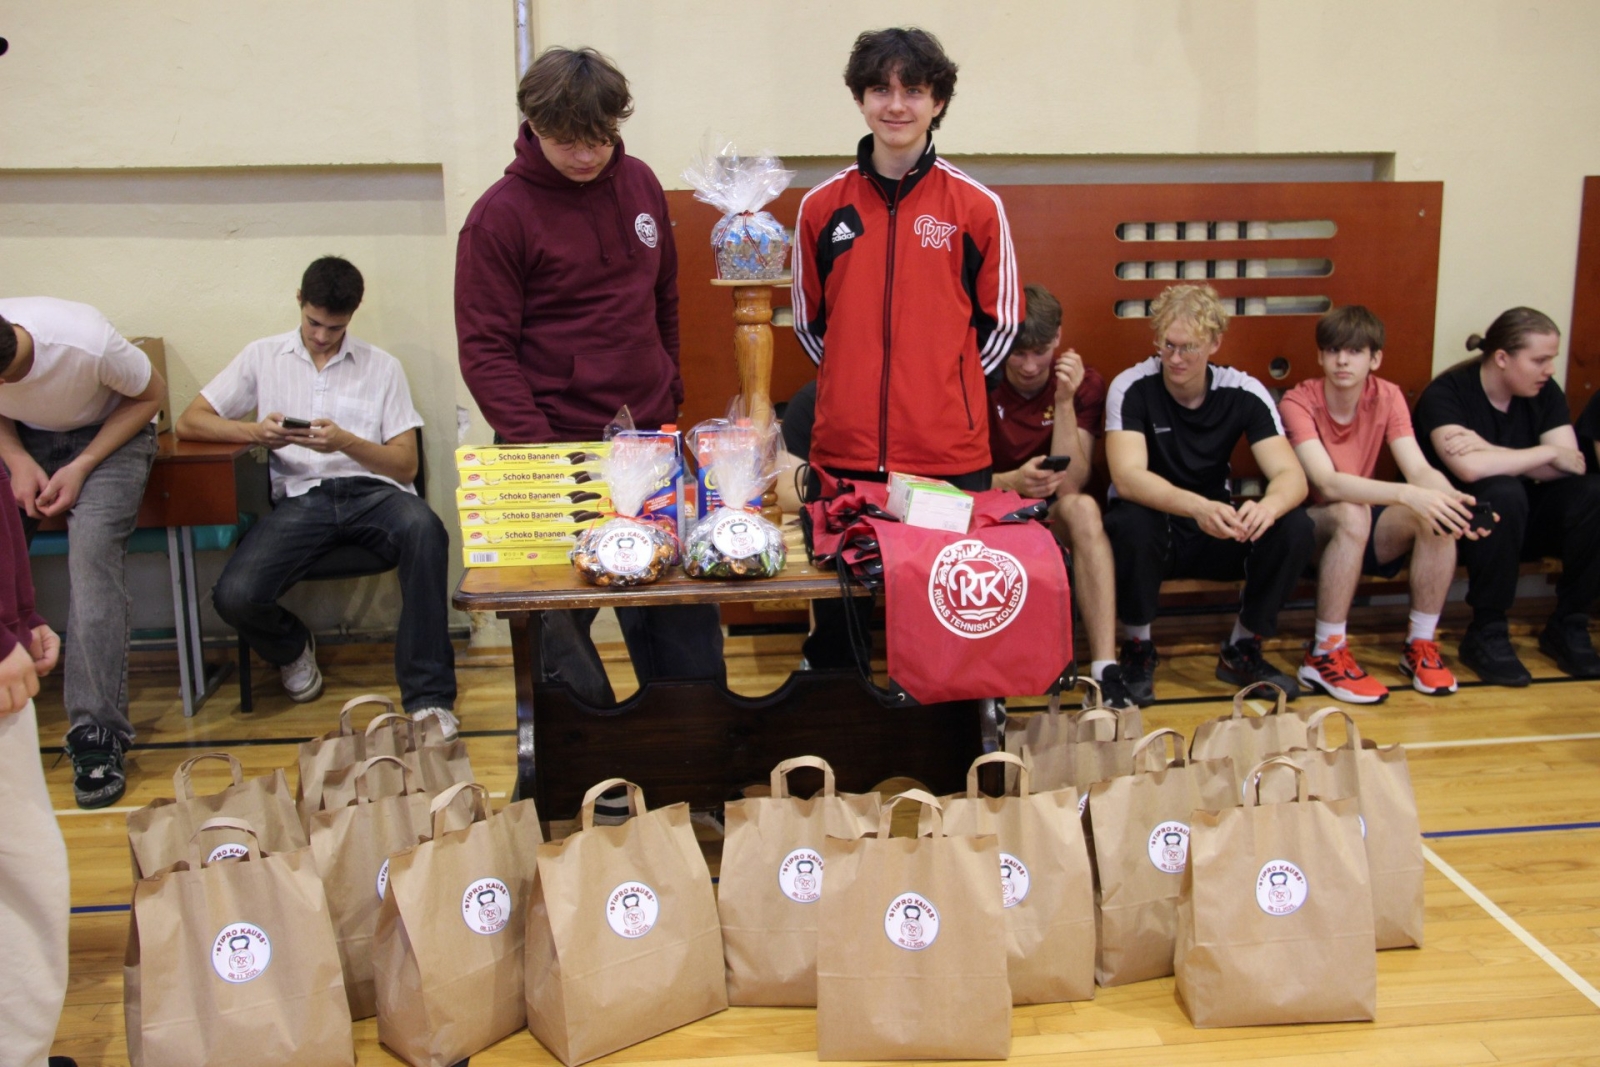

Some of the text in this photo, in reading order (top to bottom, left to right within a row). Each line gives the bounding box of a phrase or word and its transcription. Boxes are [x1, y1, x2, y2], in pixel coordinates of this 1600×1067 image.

[831, 232, 855, 243] adidas
[498, 453, 526, 461] Schoko
[532, 472, 565, 480] Bananen
[499, 492, 527, 500] Schoko
[531, 511, 564, 519] Bananen
[505, 530, 566, 539] Schoko Bananen
[933, 581, 1022, 632] RĪGAS TEHNISKĀ KOLEDŽA
